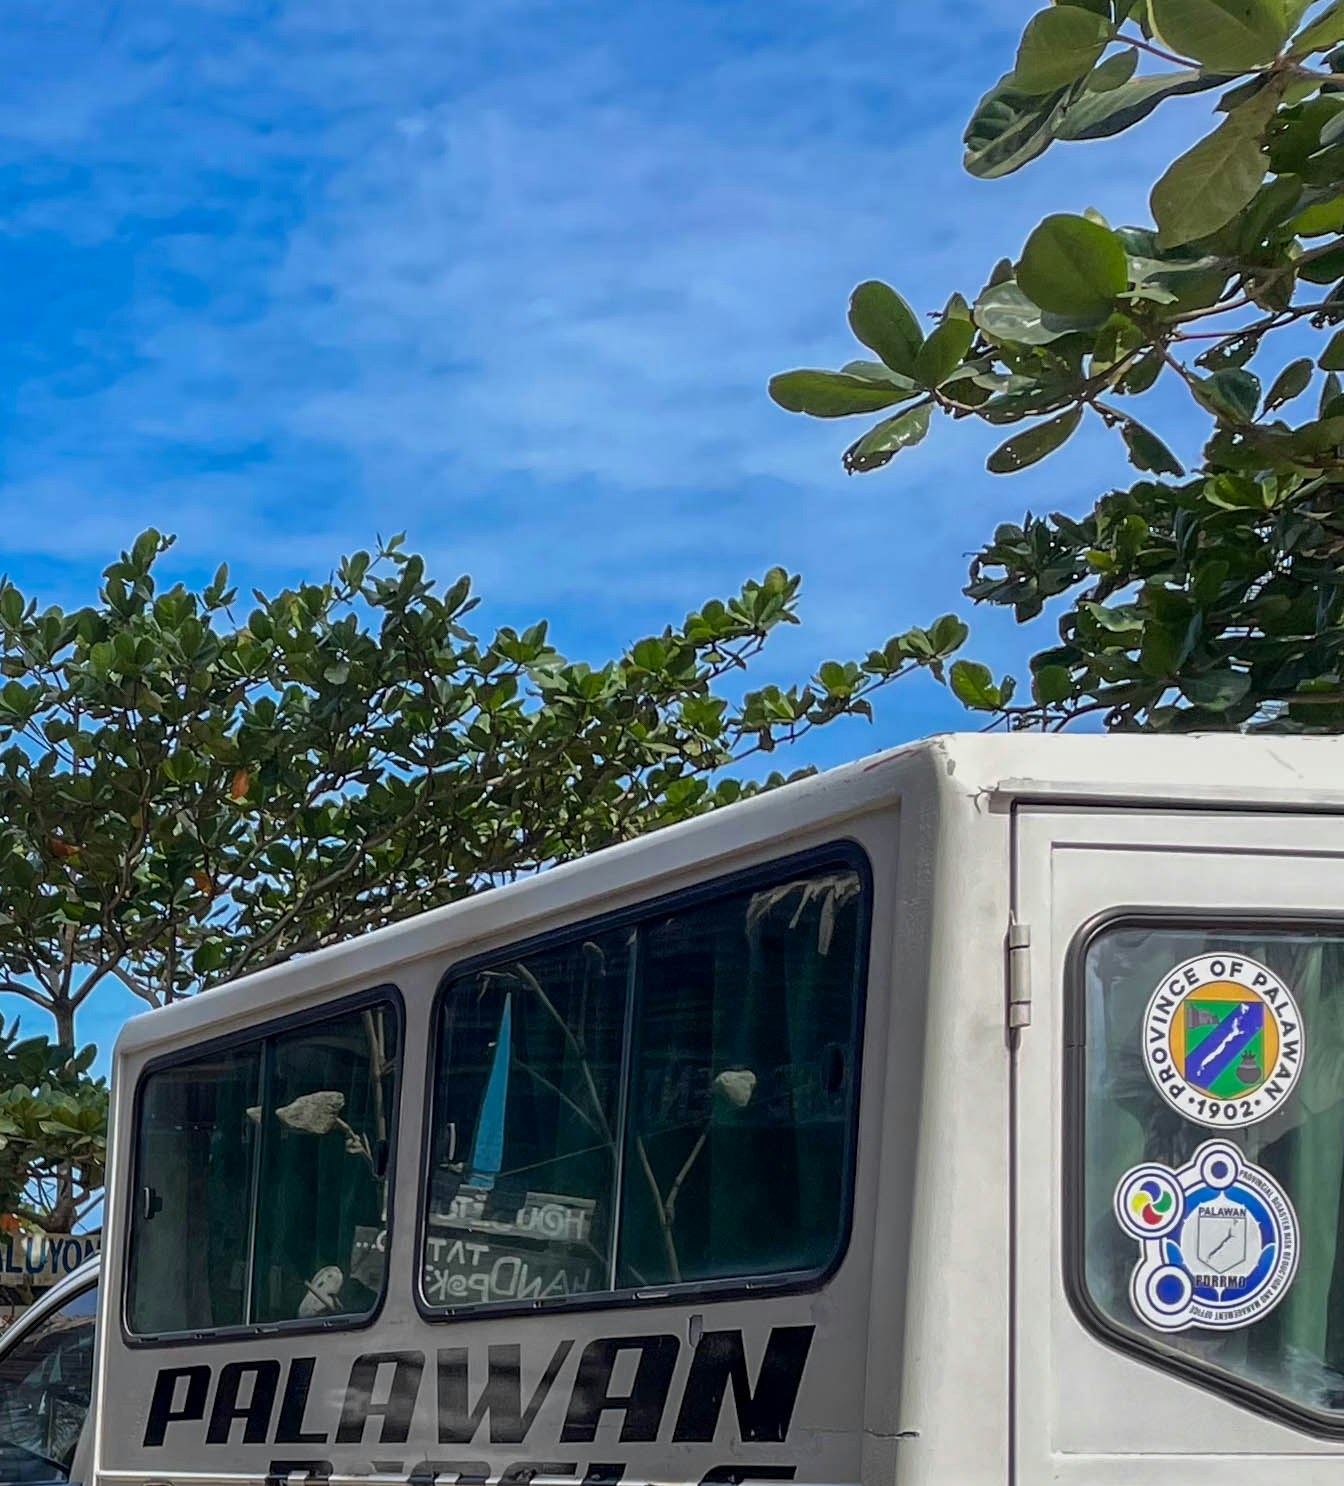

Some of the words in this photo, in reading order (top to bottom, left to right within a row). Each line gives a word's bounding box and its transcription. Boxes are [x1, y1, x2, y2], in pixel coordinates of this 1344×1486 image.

[1149, 966, 1200, 1100] PROVINCE
[1210, 960, 1243, 978] OF
[1252, 972, 1300, 1102] PALAWAN
[1196, 1099, 1255, 1121] 1902
[1197, 1206, 1247, 1217] PALAWAN
[142, 1324, 817, 1448] PALAWAN
